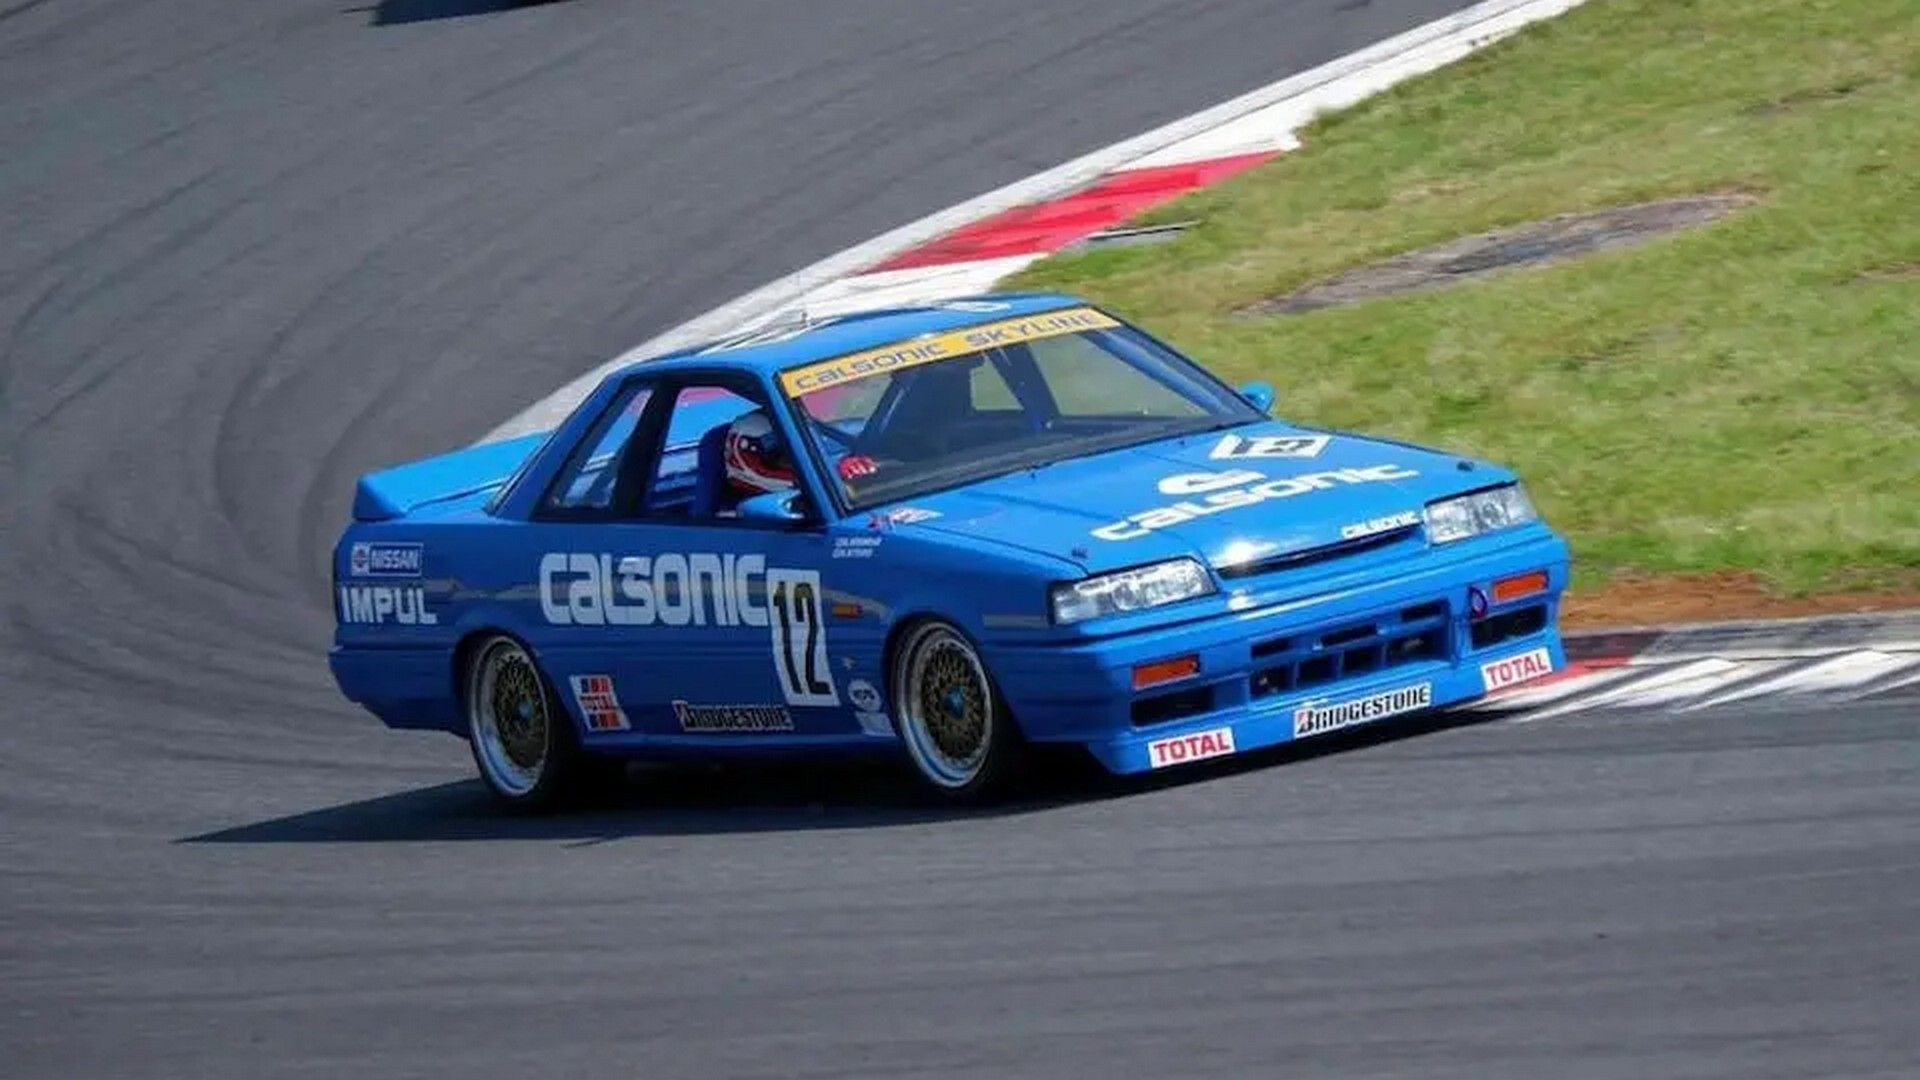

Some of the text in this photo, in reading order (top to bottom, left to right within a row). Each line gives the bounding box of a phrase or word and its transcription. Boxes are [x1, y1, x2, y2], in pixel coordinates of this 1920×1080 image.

[963, 313, 1097, 347] SKYLINE
[370, 549, 419, 569] NISSAN
[340, 586, 438, 624] IMPUL
[773, 580, 832, 695] 12
[1484, 653, 1549, 688] TOTAL
[677, 704, 791, 730] BRIDGESTONE
[1297, 685, 1430, 734] BRIDGESTONE
[1153, 732, 1230, 763] TOTAL
